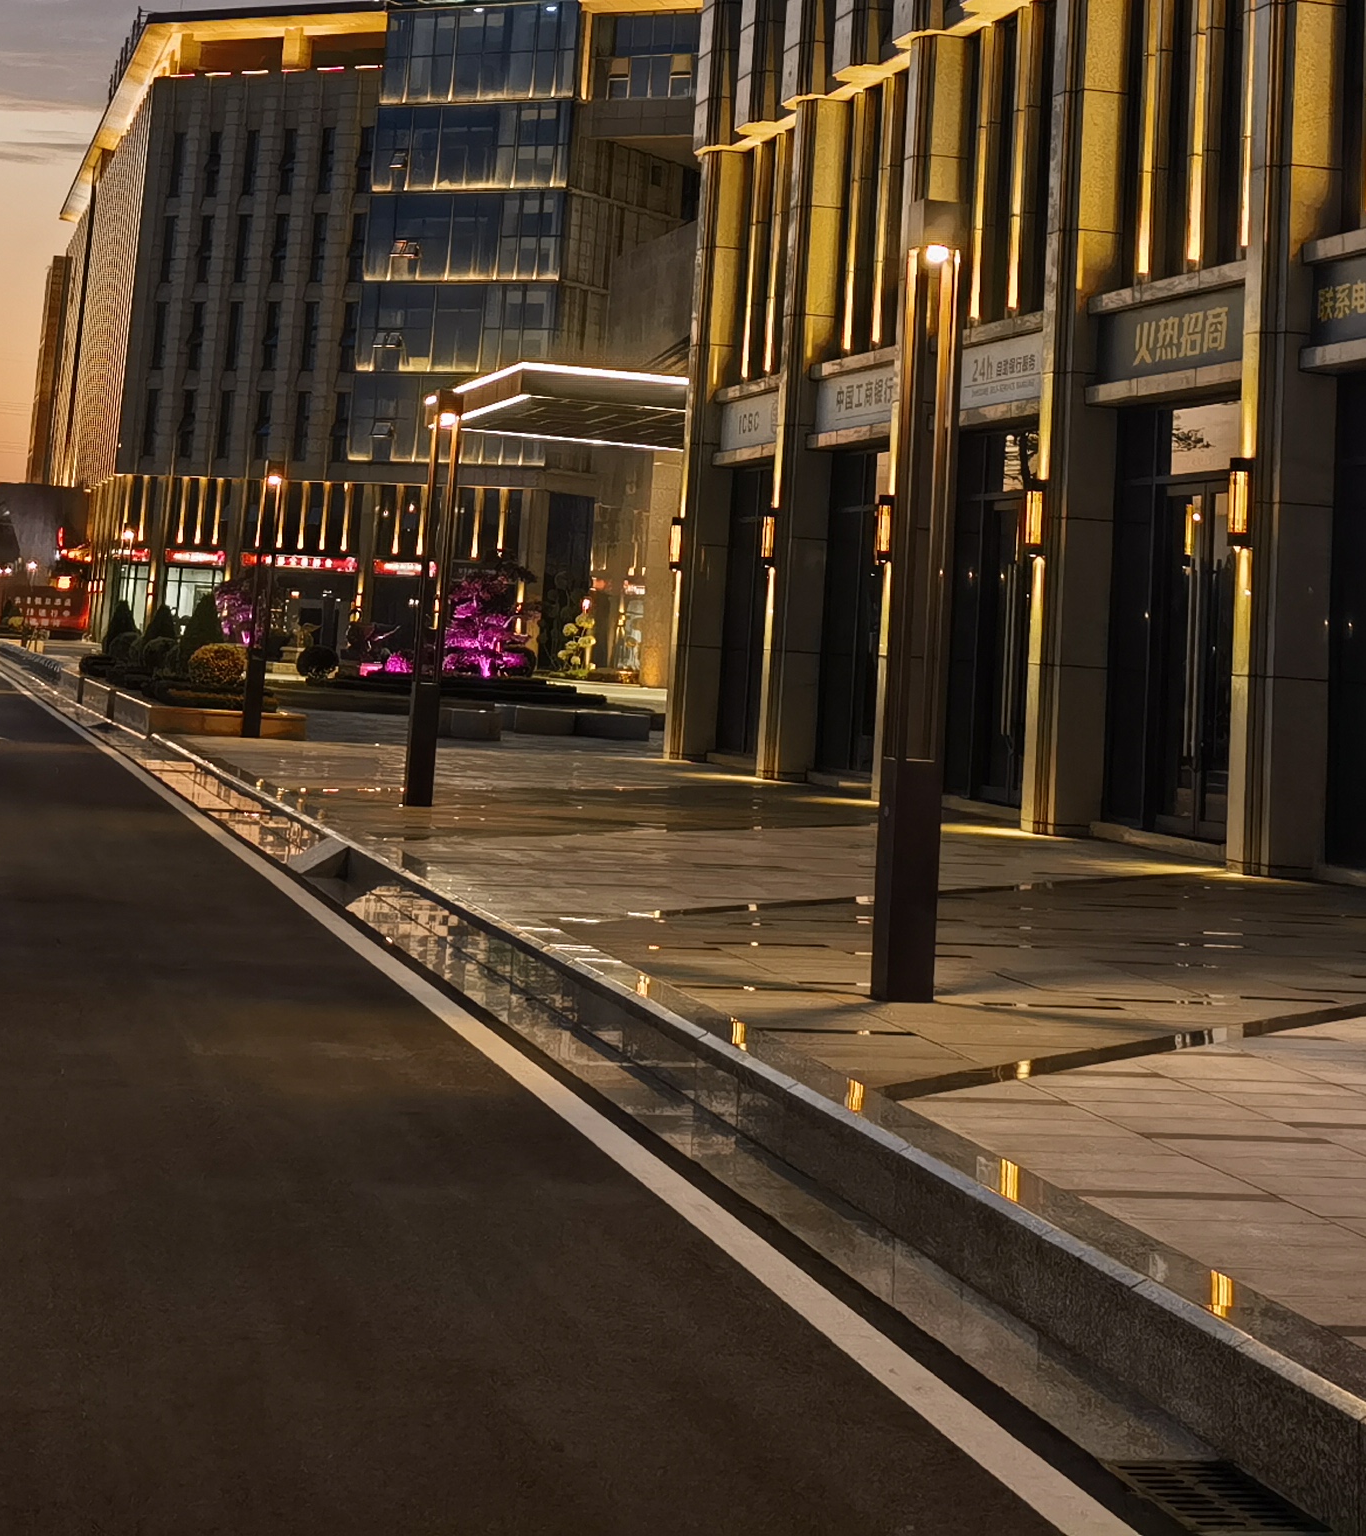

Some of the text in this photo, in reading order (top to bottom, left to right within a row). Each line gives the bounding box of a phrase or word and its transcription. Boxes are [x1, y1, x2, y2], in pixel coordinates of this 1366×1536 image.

[1133, 306, 1229, 366] 火热招商
[972, 355, 993, 382] 24h
[836, 378, 894, 413] 中国工商银行
